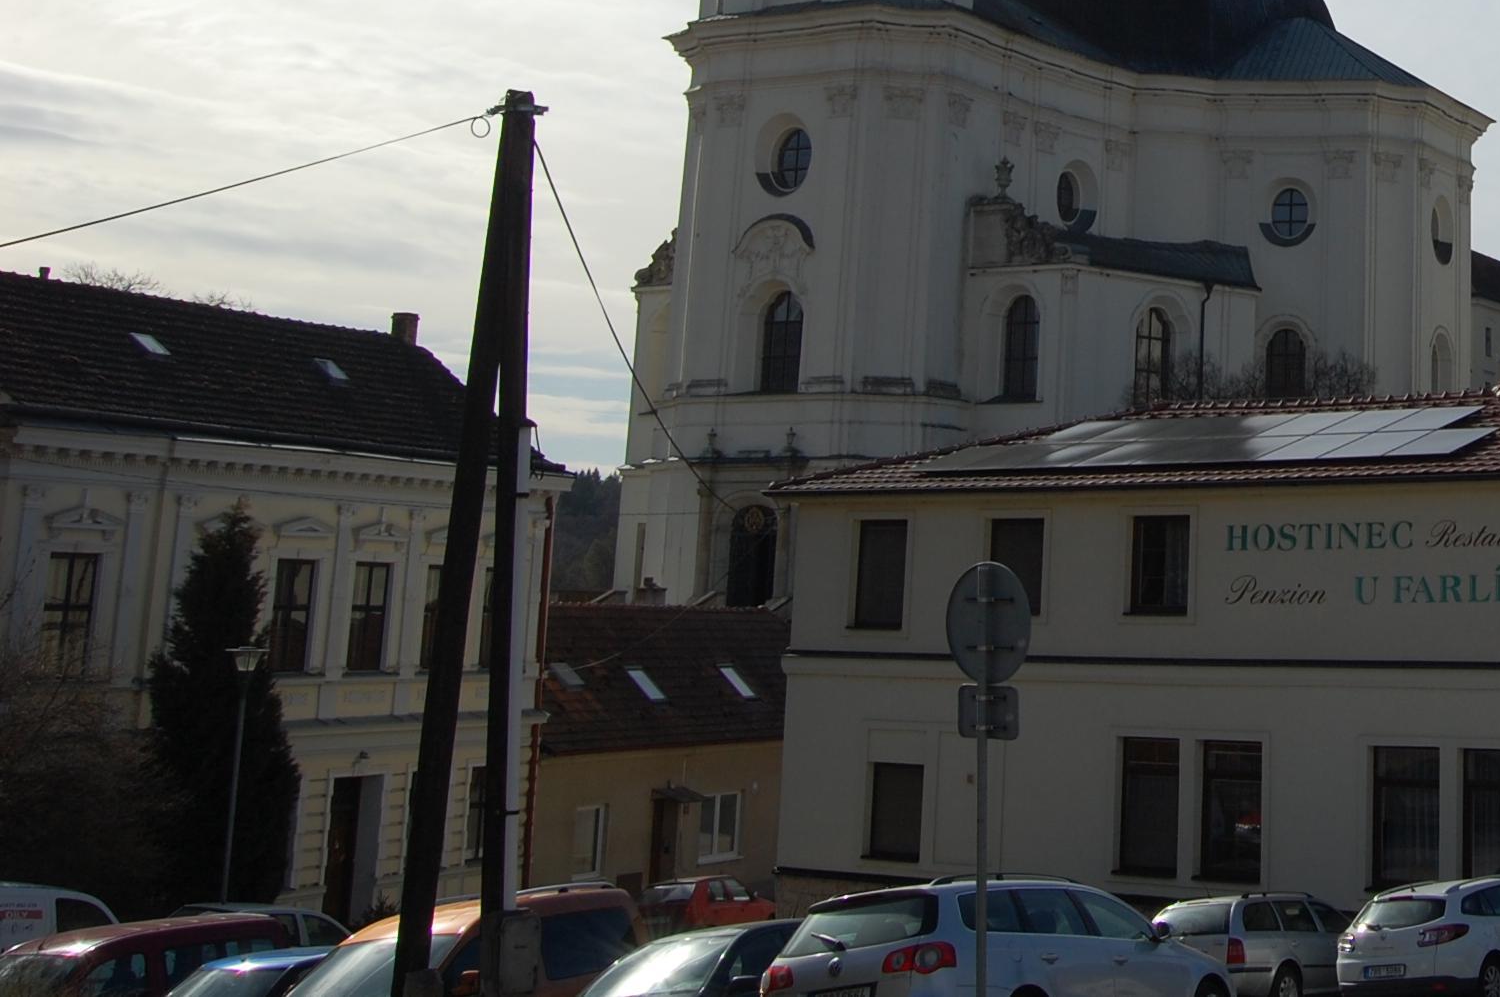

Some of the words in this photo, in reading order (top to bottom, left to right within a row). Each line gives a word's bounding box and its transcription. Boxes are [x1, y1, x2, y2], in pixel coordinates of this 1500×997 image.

[1225, 521, 1414, 552] HOSTINEC
[1225, 574, 1328, 605] Penzion
[1354, 576, 1379, 605] U
